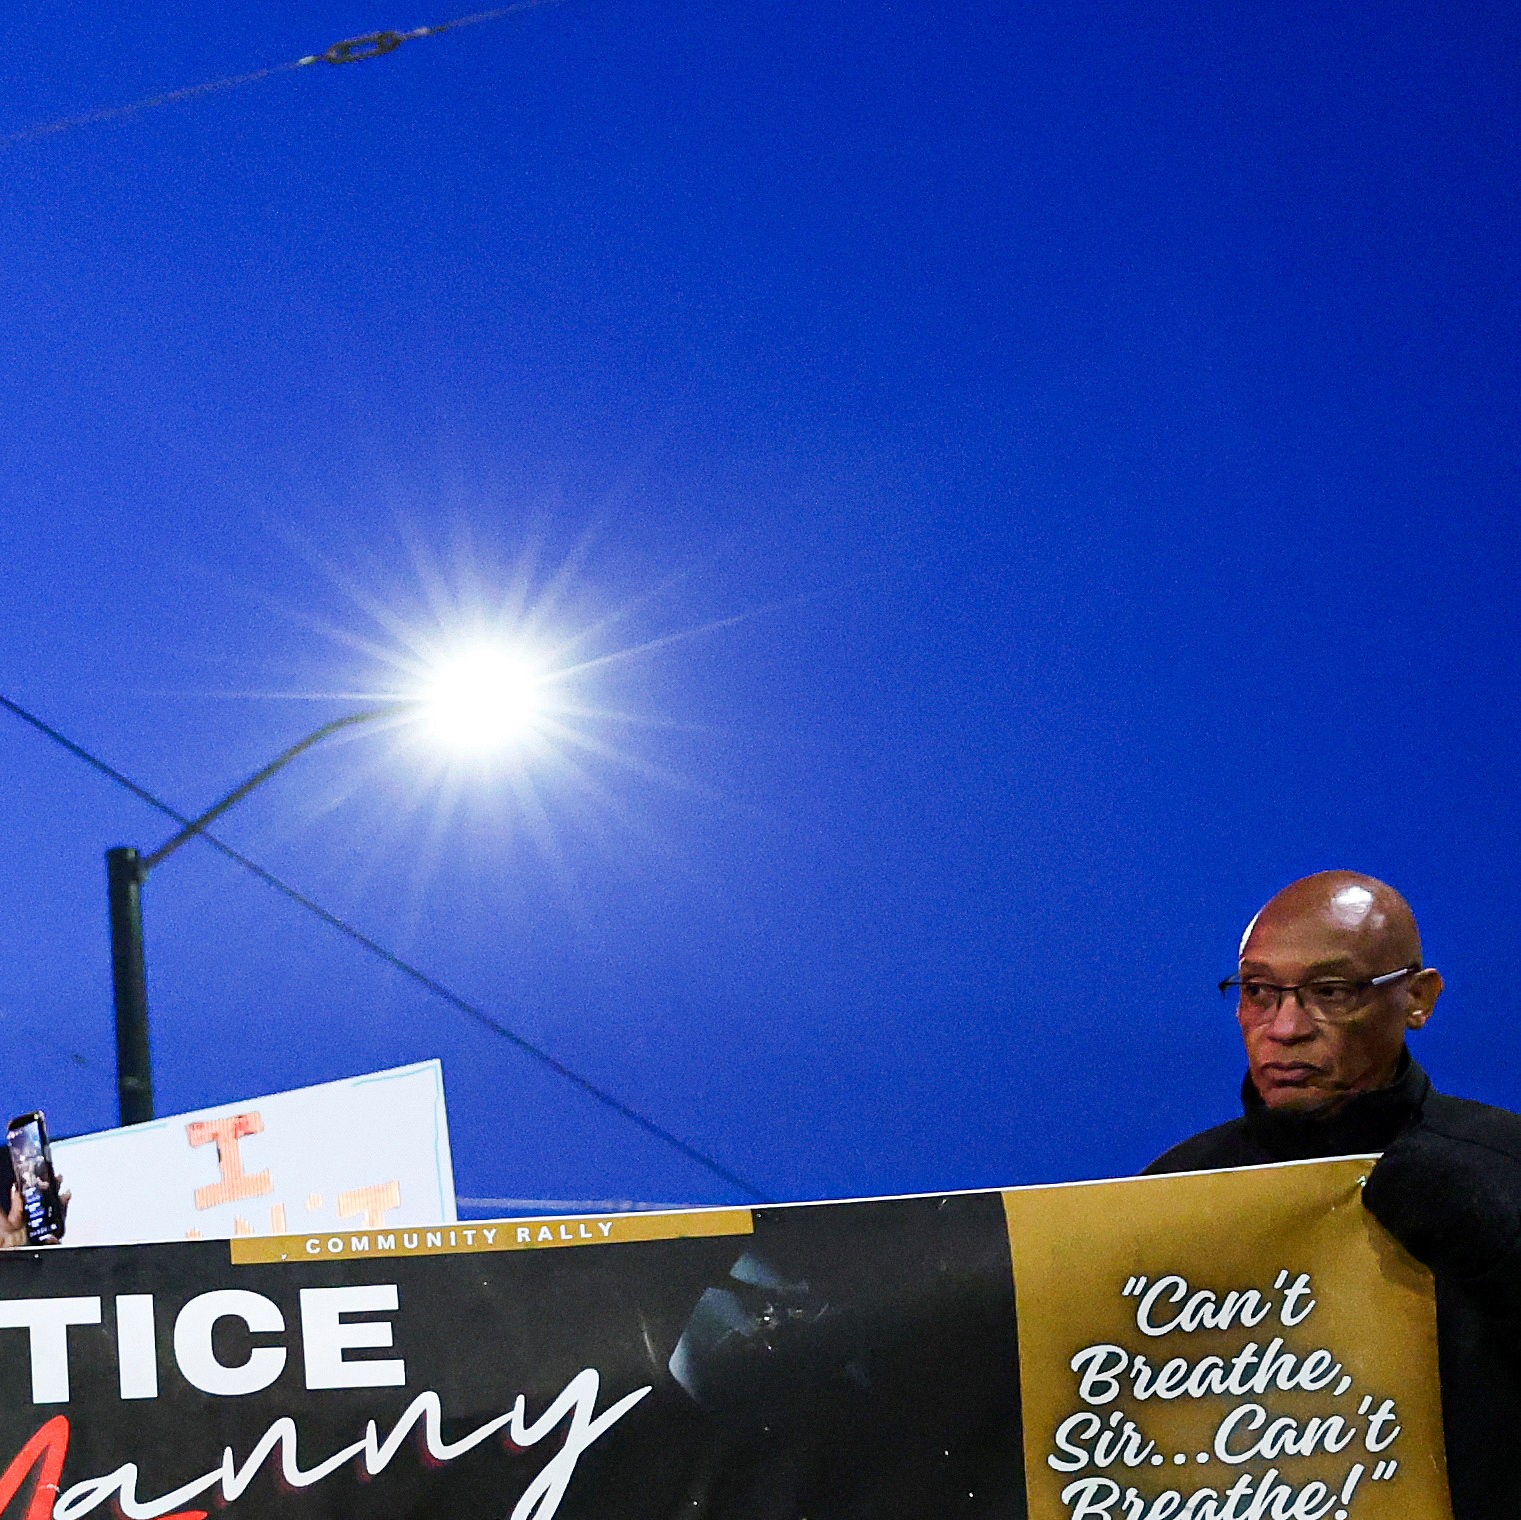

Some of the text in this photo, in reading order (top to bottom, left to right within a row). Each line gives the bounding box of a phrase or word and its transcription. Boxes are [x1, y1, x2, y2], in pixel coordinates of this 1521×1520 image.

[185, 1110, 274, 1211] I
[304, 1221, 614, 1255] COMMUNITY RALLY
[1121, 1269, 1317, 1337] "Can't
[1070, 1337, 1354, 1405] Breathe,
